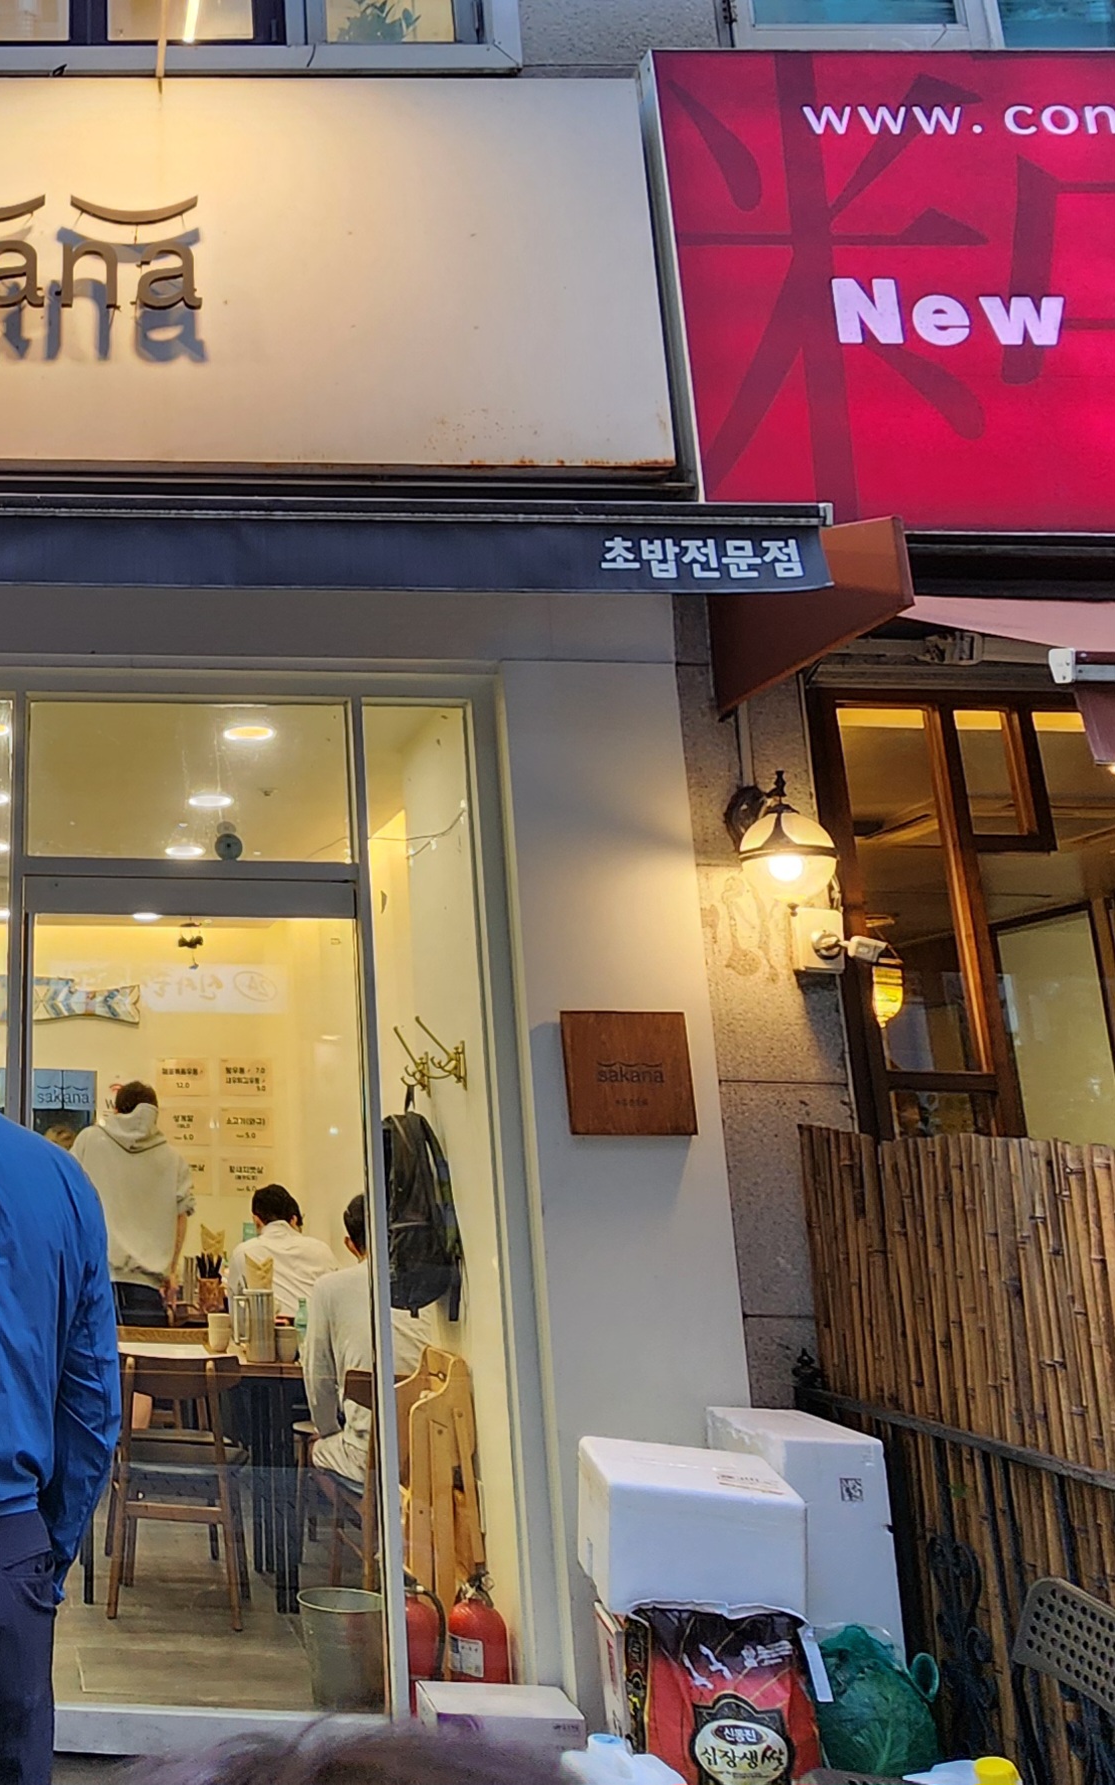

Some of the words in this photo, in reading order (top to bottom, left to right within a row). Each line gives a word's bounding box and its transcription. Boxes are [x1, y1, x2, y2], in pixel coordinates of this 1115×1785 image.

[831, 277, 1065, 346] New
[600, 536, 805, 580] 초밥전문점
[597, 1065, 665, 1084] sakana
[37, 1089, 90, 1104] sakana
